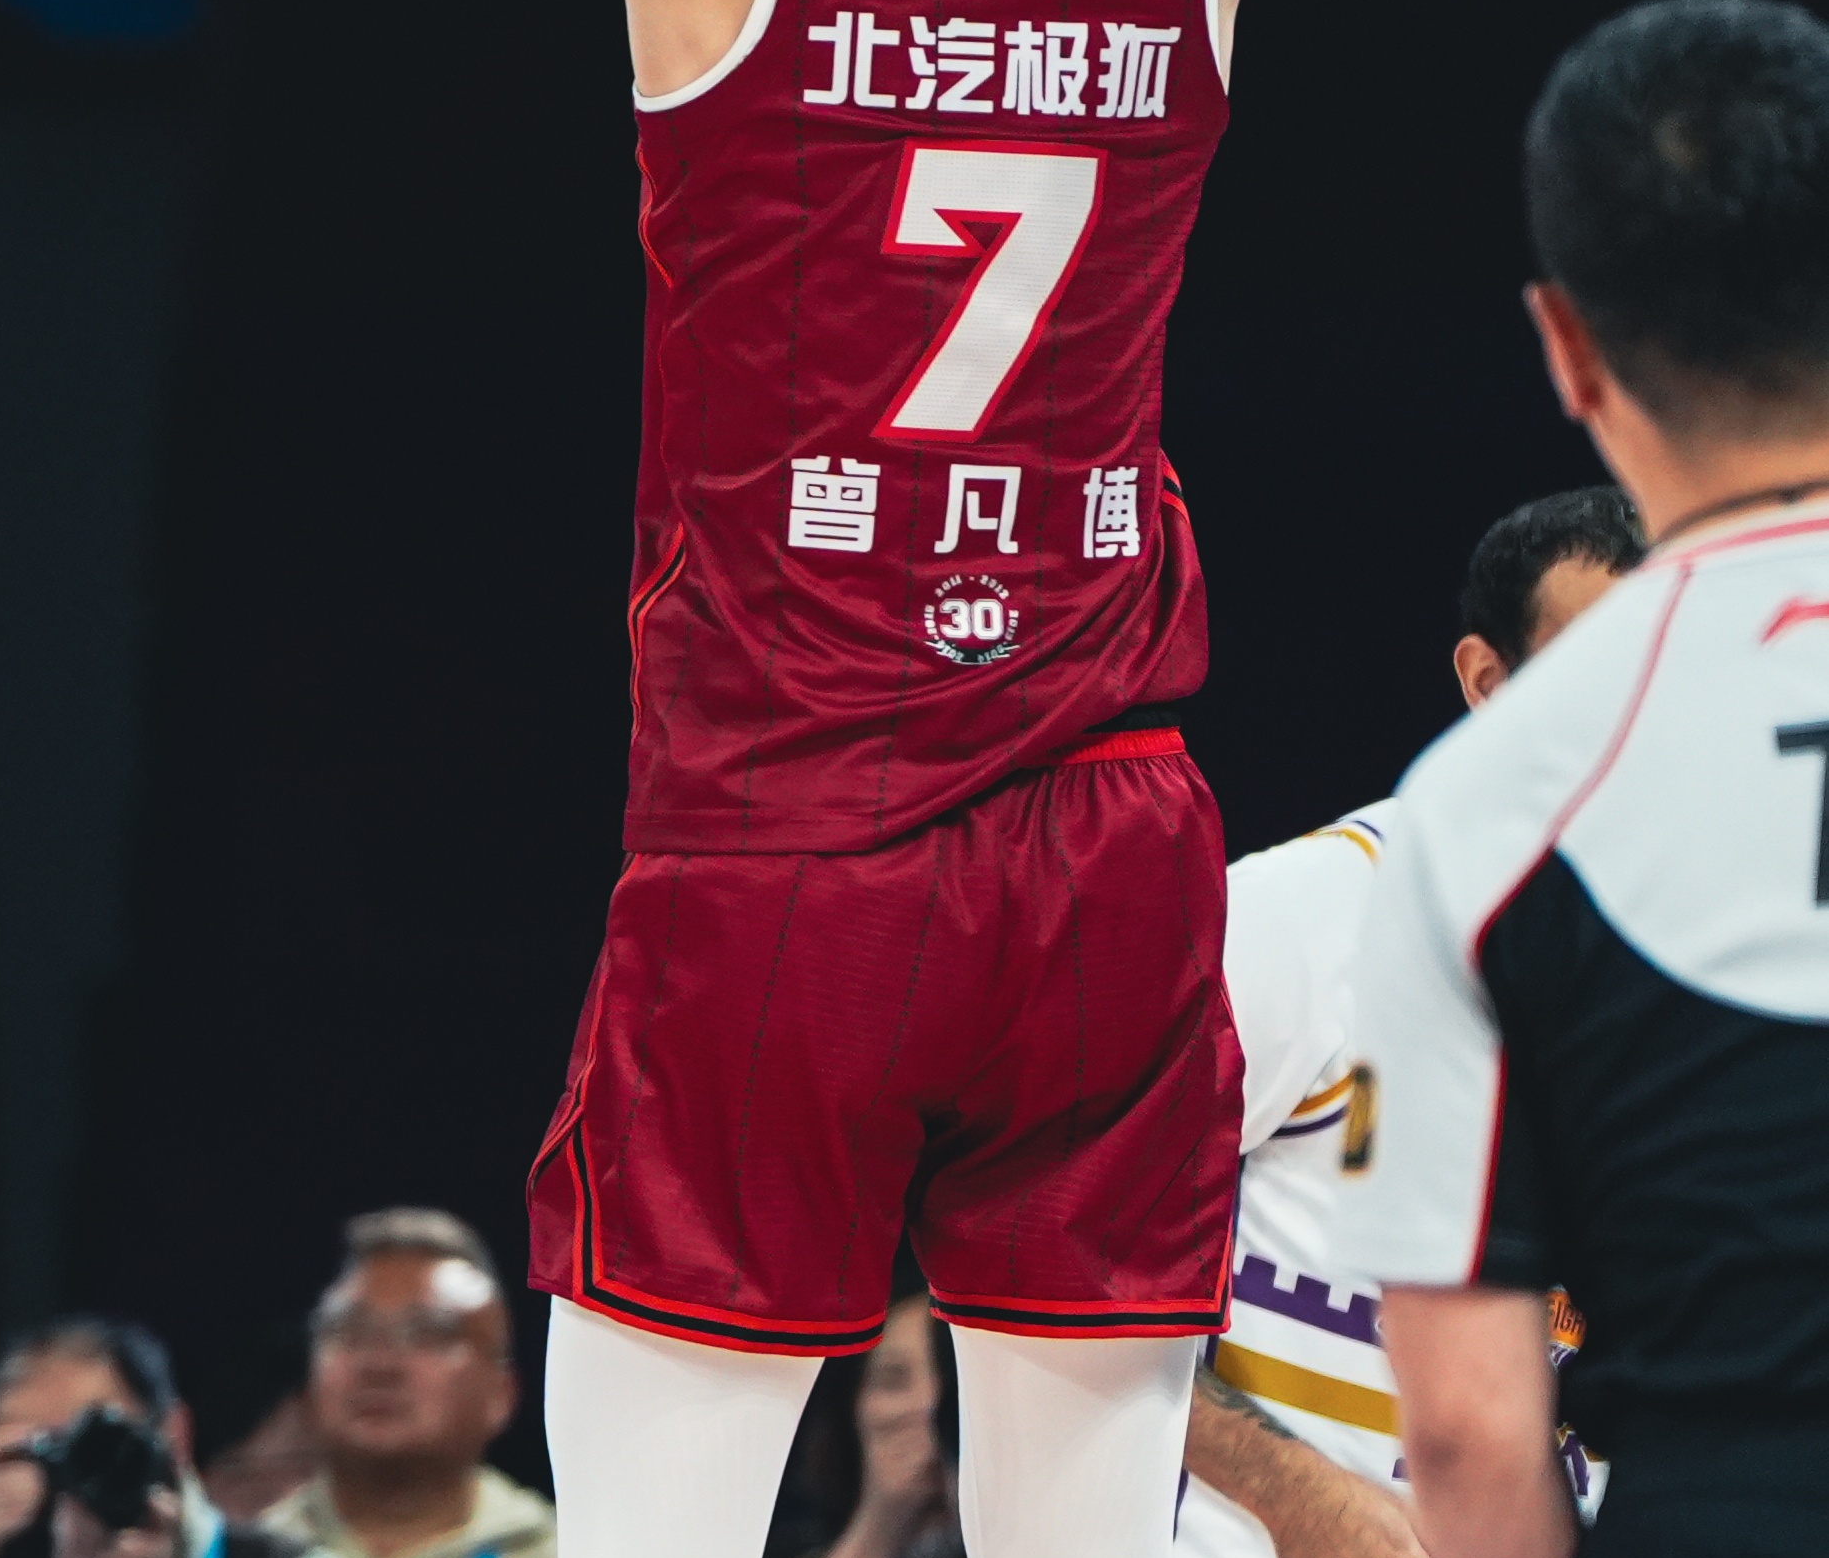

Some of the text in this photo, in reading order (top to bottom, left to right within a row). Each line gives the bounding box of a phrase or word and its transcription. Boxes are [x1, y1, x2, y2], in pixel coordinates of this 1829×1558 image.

[803, 10, 1183, 119] 北汽极狐
[870, 139, 1109, 442] 7
[787, 454, 1141, 560] 曾凡博
[939, 598, 1005, 641] 30
